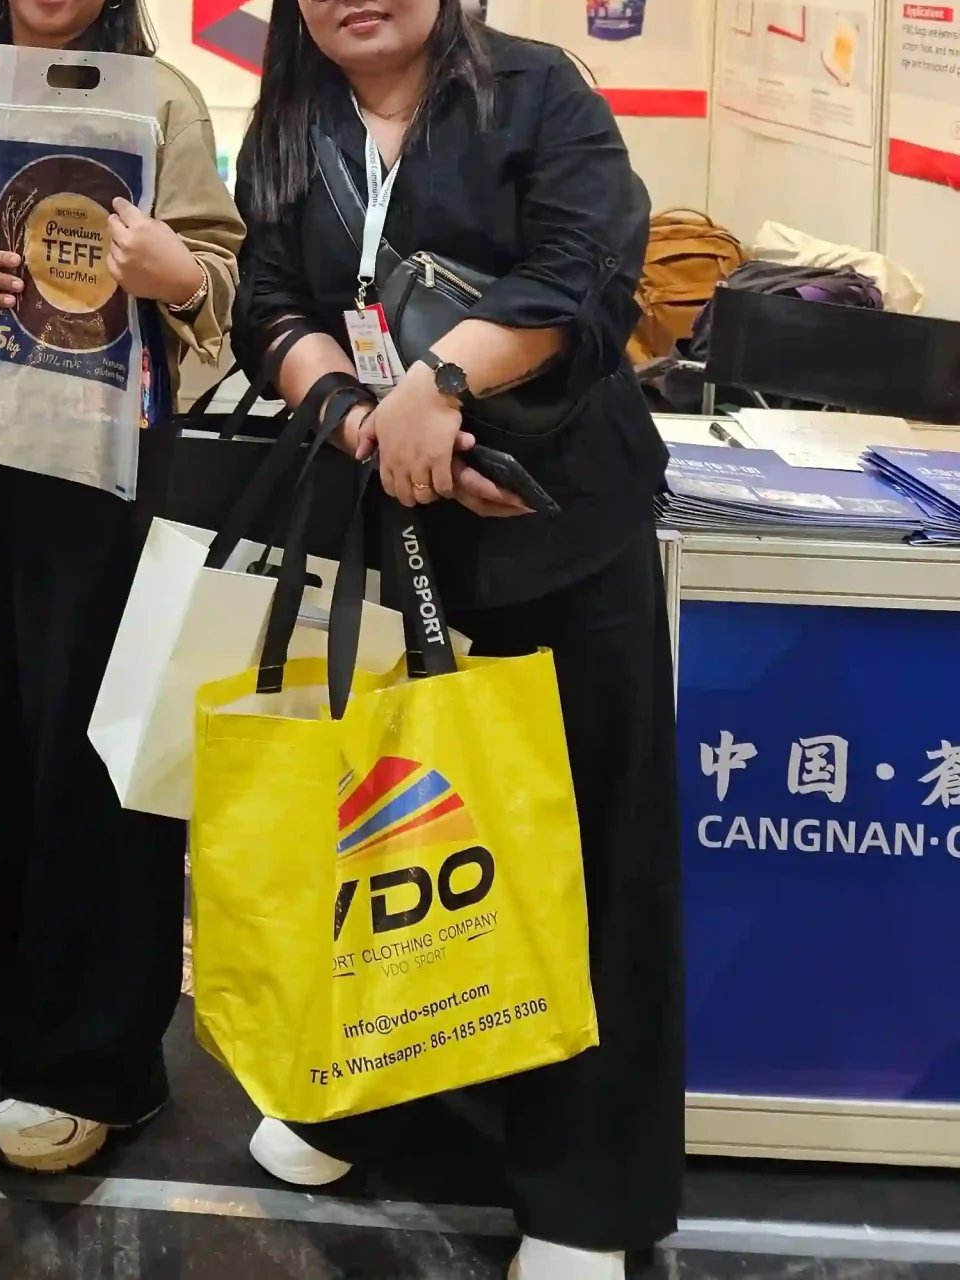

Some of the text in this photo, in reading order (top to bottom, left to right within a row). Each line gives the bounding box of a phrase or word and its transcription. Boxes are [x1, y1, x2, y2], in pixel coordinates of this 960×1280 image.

[41, 237, 104, 269] TEFF
[45, 220, 104, 242] Premium
[401, 524, 445, 646] VDO SPORT
[361, 933, 434, 964] CLOTHING
[438, 910, 499, 942] COMPANY
[381, 947, 448, 979] VDO SPORT
[342, 981, 491, 1040] info@vdo-sport.com
[331, 1062, 344, 1079] &
[346, 1039, 428, 1077] Whatsapp:
[429, 1020, 477, 1050] 86-185
[477, 1009, 513, 1035] 5925
[514, 997, 549, 1021] 8306
